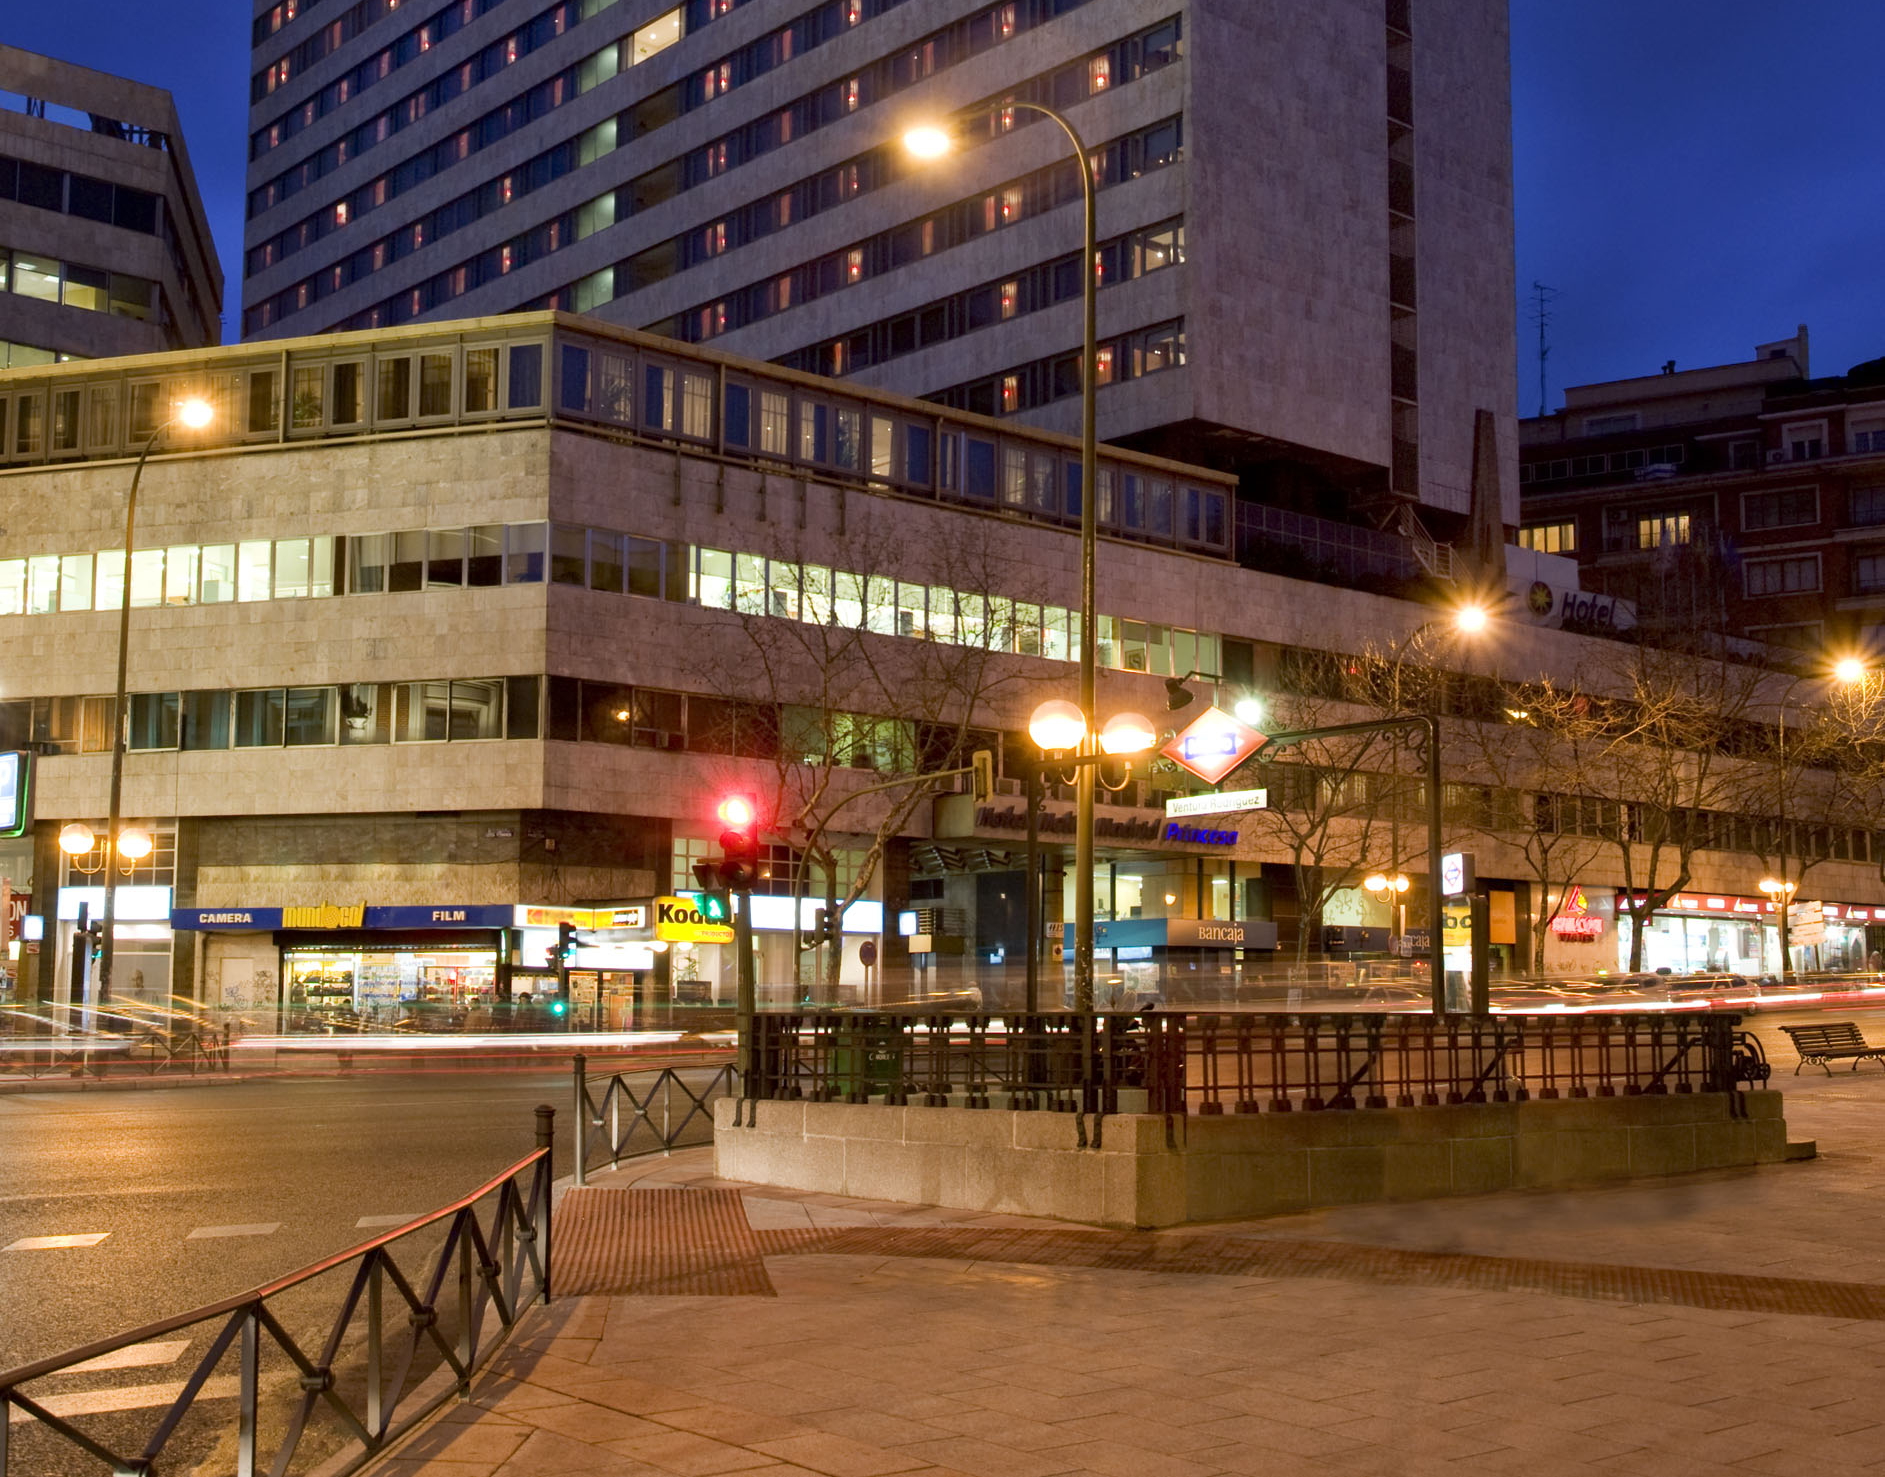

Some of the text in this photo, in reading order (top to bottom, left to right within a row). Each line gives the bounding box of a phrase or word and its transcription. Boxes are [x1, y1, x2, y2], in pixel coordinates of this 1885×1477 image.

[1561, 591, 1617, 624] Hotel
[1165, 822, 1238, 845] Princesa
[199, 912, 252, 924] CAMERA
[432, 910, 465, 921] FILM
[658, 903, 721, 926] Kod
